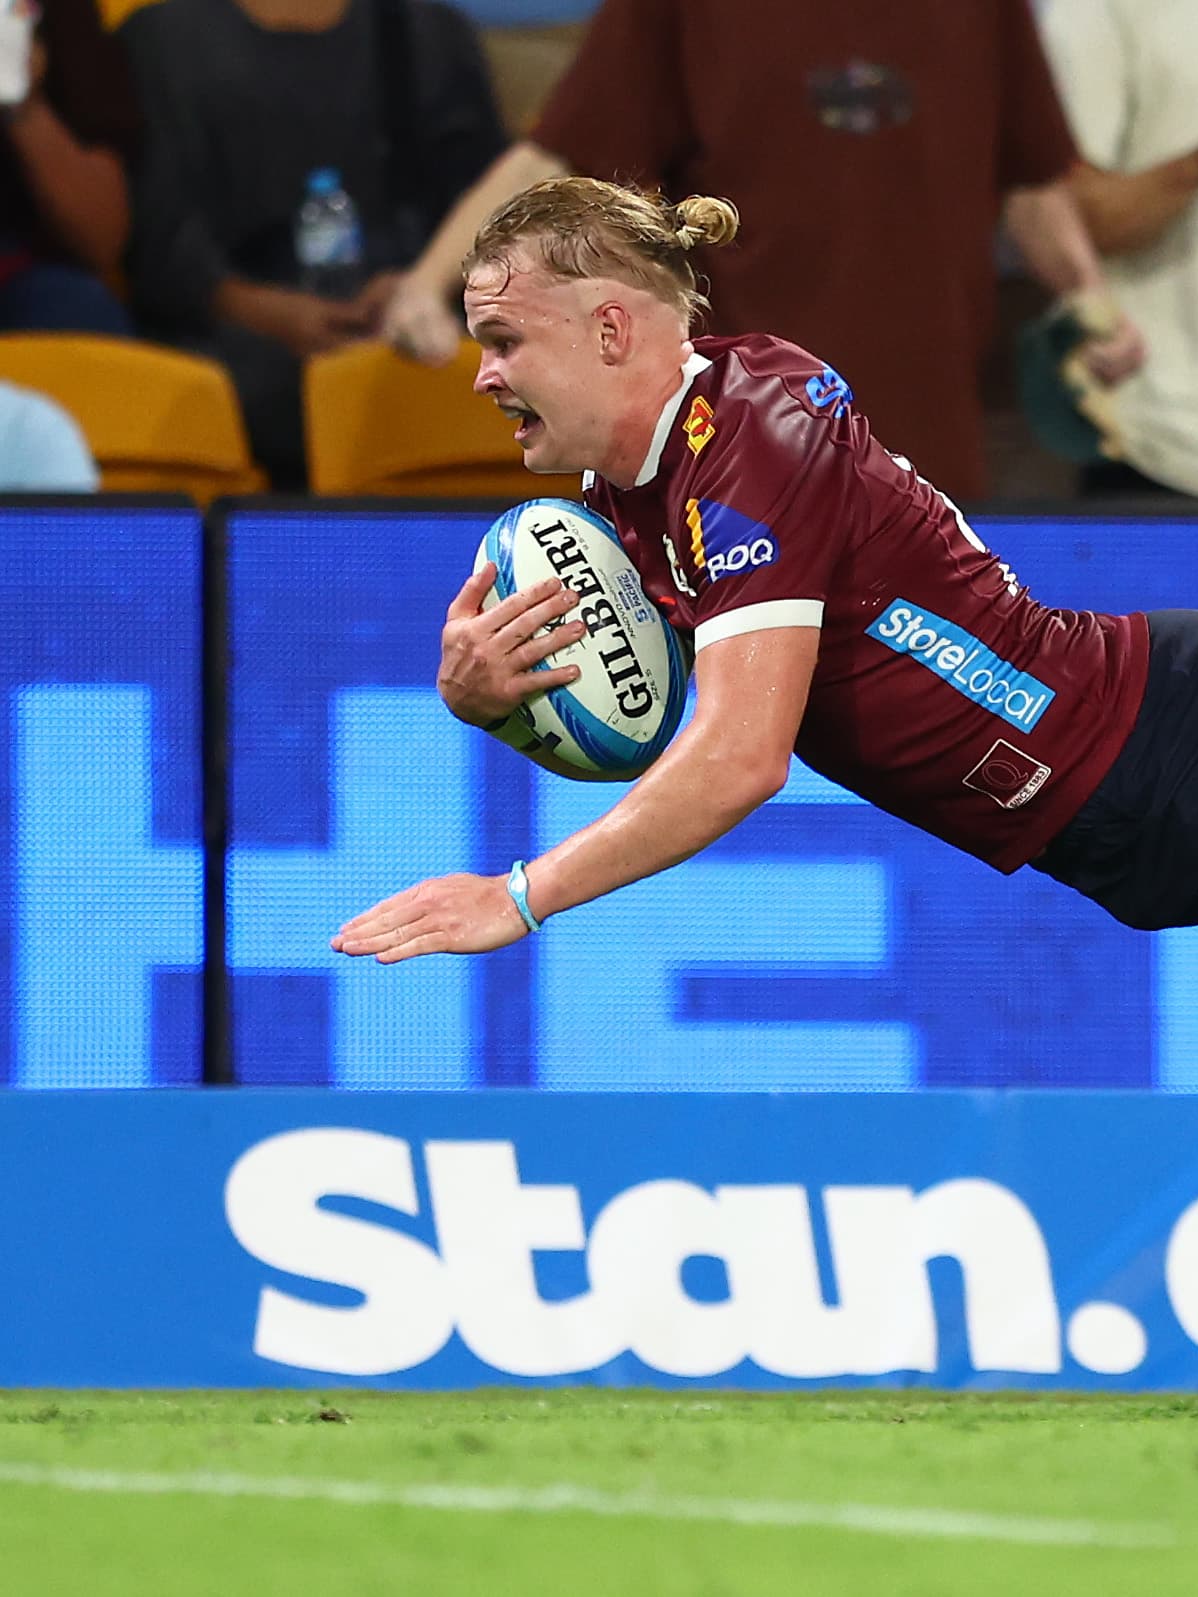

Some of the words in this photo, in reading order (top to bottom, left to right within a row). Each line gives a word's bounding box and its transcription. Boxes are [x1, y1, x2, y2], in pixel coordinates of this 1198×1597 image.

[530, 519, 653, 718] GILBERT
[620, 573, 642, 607] PACIFIC
[878, 607, 1047, 725] StoreLocal
[224, 1126, 1148, 1378] Stan.
